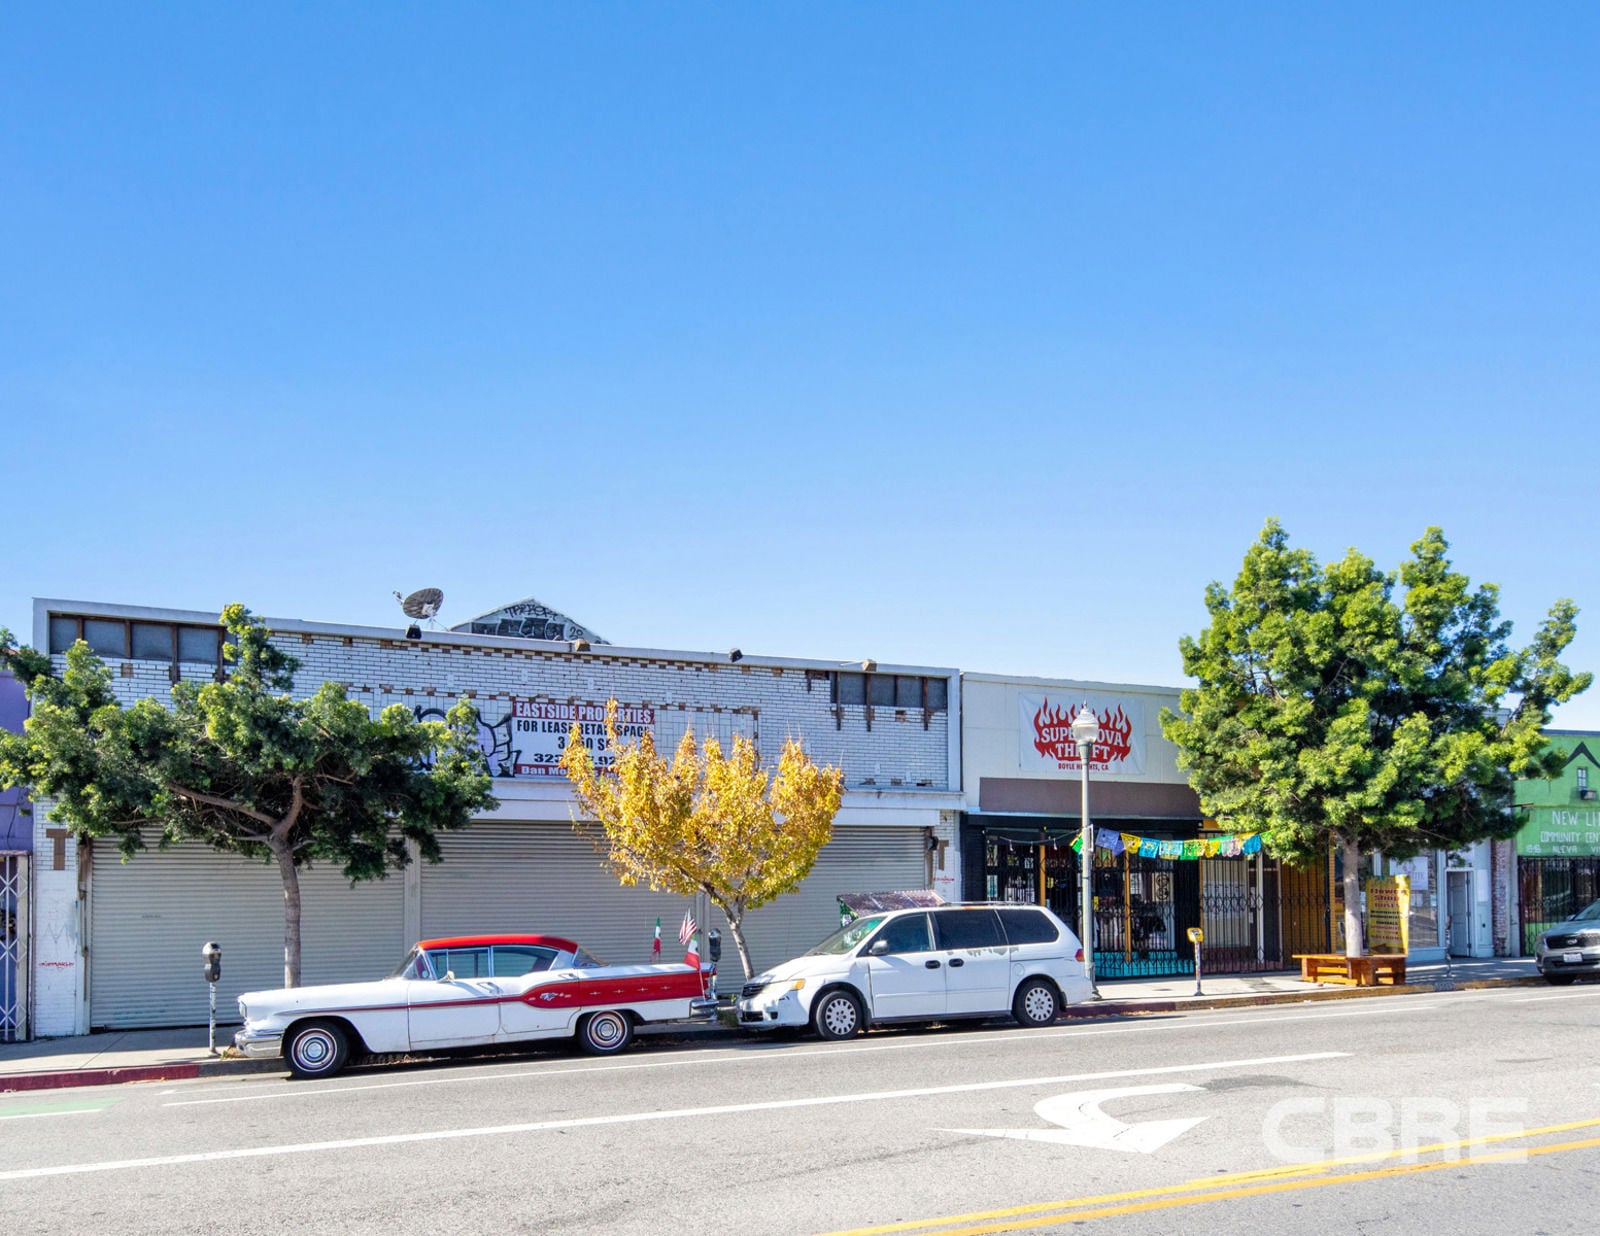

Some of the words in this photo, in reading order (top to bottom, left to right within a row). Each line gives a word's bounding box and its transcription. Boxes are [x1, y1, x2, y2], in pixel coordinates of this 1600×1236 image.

[515, 702, 576, 719] EASTSIDE
[578, 706, 652, 723] PRORTIES
[517, 719, 538, 732] FOR
[1041, 727, 1124, 746] SUPEOVA
[1552, 810, 1578, 825] NEW
[1540, 831, 1580, 843] COMMUNITY
